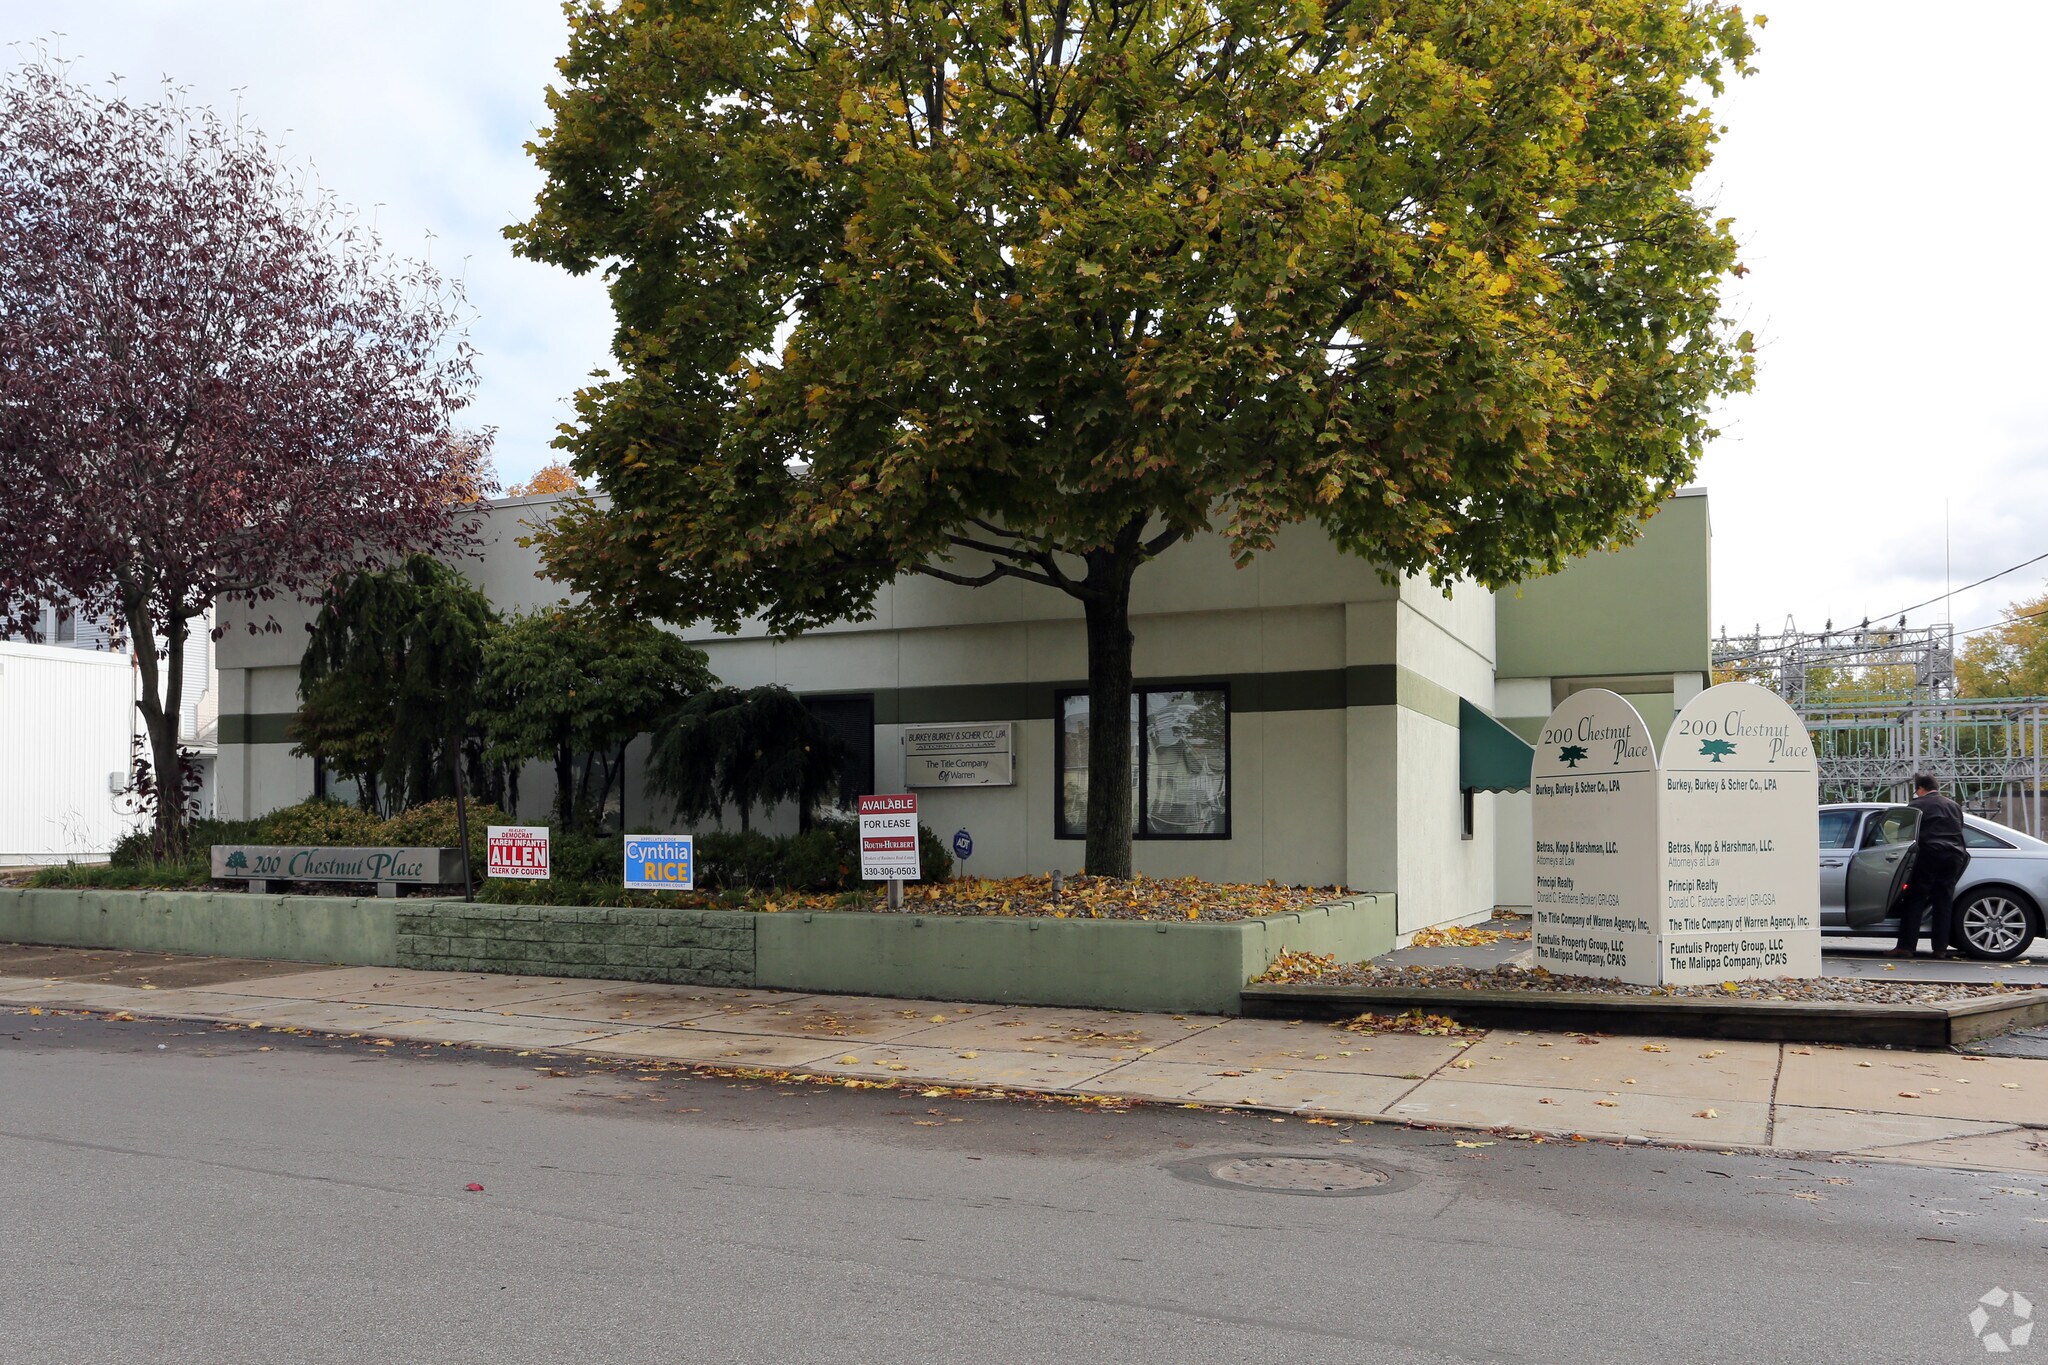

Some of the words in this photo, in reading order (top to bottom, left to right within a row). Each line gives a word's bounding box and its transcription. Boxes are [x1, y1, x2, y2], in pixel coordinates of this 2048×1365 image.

[1545, 728, 1572, 744] 200
[1578, 715, 1631, 741] Chestnut
[1680, 720, 1717, 735] 200
[1724, 710, 1789, 736] Chestnut
[932, 732, 955, 741] BURKEY
[956, 732, 960, 740] &
[1613, 737, 1647, 765] Place
[1768, 736, 1808, 763] Place
[956, 760, 988, 768] Company
[939, 771, 950, 782] Of
[1536, 784, 1554, 797] Burkey,
[1556, 783, 1573, 796] Burkey
[1575, 782, 1579, 792] &
[1581, 782, 1596, 793] Scher
[1609, 780, 1620, 791] LPA
[1668, 779, 1693, 793] Burkey,
[1695, 778, 1719, 793] Burkey
[1721, 779, 1726, 790] &
[1728, 779, 1747, 790] Scher
[1750, 779, 1762, 792] Co.,
[1765, 779, 1777, 790] LPA
[862, 800, 913, 810] AVAILABLE
[883, 820, 910, 828] LEASE
[956, 838, 970, 849] ADT
[1537, 841, 1554, 854] Betras,
[1556, 842, 1569, 855] Kopp
[1570, 842, 1574, 852] &
[1576, 842, 1604, 855] Harshman,
[1606, 842, 1618, 853] LLC.
[1668, 841, 1692, 854] Betras,
[1695, 841, 1712, 855] Kopp
[1714, 841, 1719, 852] &
[1722, 840, 1758, 854] Harshman,
[1760, 840, 1774, 852] LLC.
[491, 847, 545, 866] ALLEN
[627, 843, 688, 863] Cynthia
[252, 855, 281, 873] 200
[288, 849, 364, 877] Chestnut
[366, 850, 423, 880] Place
[1536, 856, 1558, 867] Attorneys
[1559, 857, 1564, 866] at
[1565, 857, 1575, 866] Law
[1668, 857, 1698, 869] Attorneys
[1699, 858, 1705, 866] at
[1707, 857, 1720, 867] Law
[645, 862, 688, 881] RICE
[864, 867, 916, 875] 330-306-0503
[1537, 876, 1556, 889] Principi
[1558, 877, 1574, 890] Realty
[1668, 880, 1694, 893] Principi
[1696, 879, 1718, 893] Realty
[1669, 896, 1688, 908] Donald
[1691, 896, 1696, 908] C.
[1726, 894, 1748, 909] (Broker)
[1750, 894, 1776, 905] GRI-GSA
[1538, 912, 1547, 923] The
[1548, 912, 1560, 924] Title
[1561, 913, 1585, 928] Company
[1586, 915, 1593, 926] of
[1593, 915, 1613, 927] Warren
[1614, 917, 1636, 931] Agency,
[1638, 918, 1649, 930] Inc.
[1669, 919, 1682, 930] The
[1684, 918, 1700, 930] Title
[1702, 918, 1733, 931] Company
[1736, 916, 1742, 928] of
[1744, 916, 1768, 928] Warren
[1770, 915, 1796, 929] Agency,
[1798, 915, 1809, 926] Inc.
[1537, 933, 1560, 946] Funtulis
[1562, 936, 1587, 951] Property
[1589, 938, 1609, 952] Group,
[1612, 940, 1624, 952] LLC
[1671, 942, 1702, 954] Funtulis
[1705, 941, 1739, 954] Property
[1741, 940, 1766, 953] Group,
[1769, 939, 1784, 950] LLC
[1537, 946, 1548, 958] The
[1550, 947, 1573, 963] Malippa
[1575, 950, 1605, 967] Company,
[1608, 953, 1626, 967] CPA'S
[1671, 958, 1686, 970] The
[1689, 957, 1720, 971] Malippa
[1723, 955, 1762, 969] Company,
[1765, 953, 1787, 965] CPA'S
